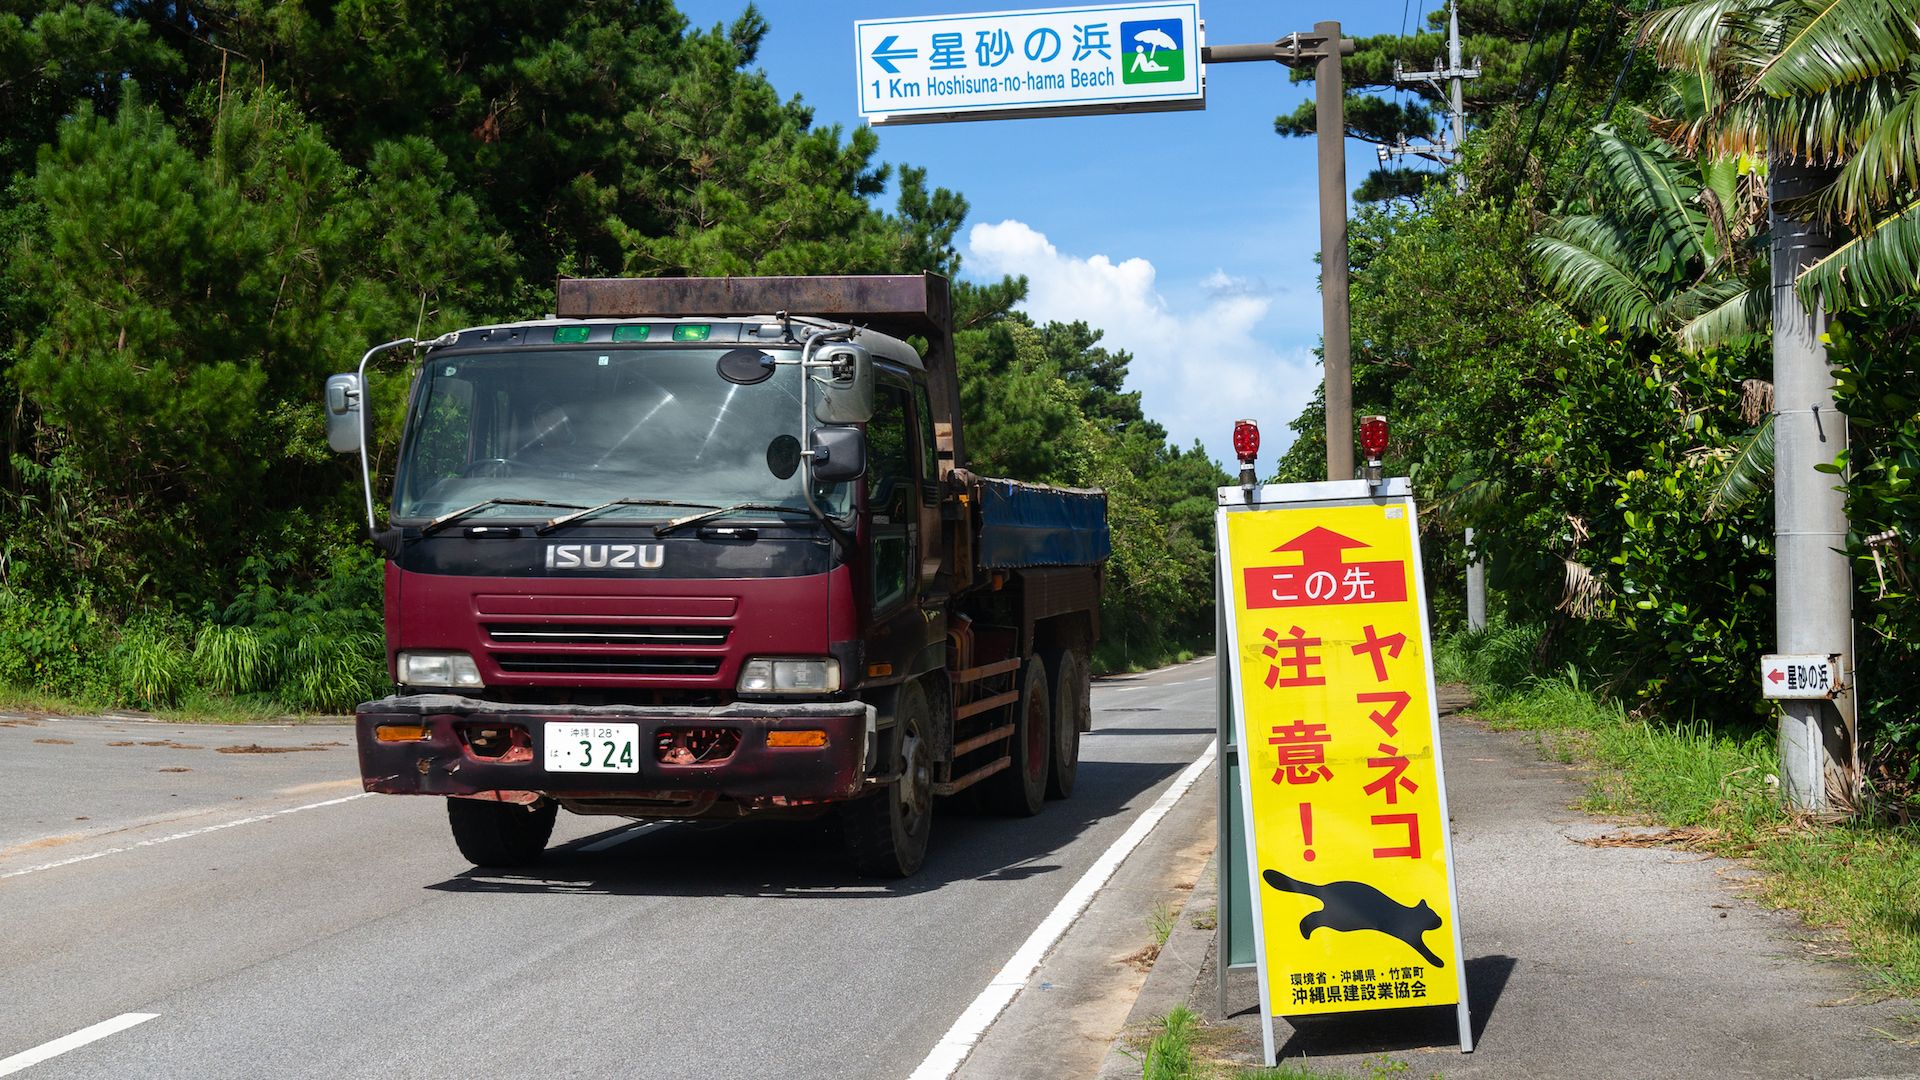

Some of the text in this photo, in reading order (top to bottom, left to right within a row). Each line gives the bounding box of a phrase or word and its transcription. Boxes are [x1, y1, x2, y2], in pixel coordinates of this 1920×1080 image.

[929, 22, 1112, 71] 星砂の浜
[871, 67, 1115, 99] 1 Km Hoshisuna-no-hama Beach
[546, 545, 664, 568] ISUZU
[1271, 566, 1376, 601] この先
[1787, 664, 1829, 690] 星砂の浜
[1351, 624, 1422, 859] ヤマネコ
[1292, 980, 1427, 1005] 沖縄県建設業協会
